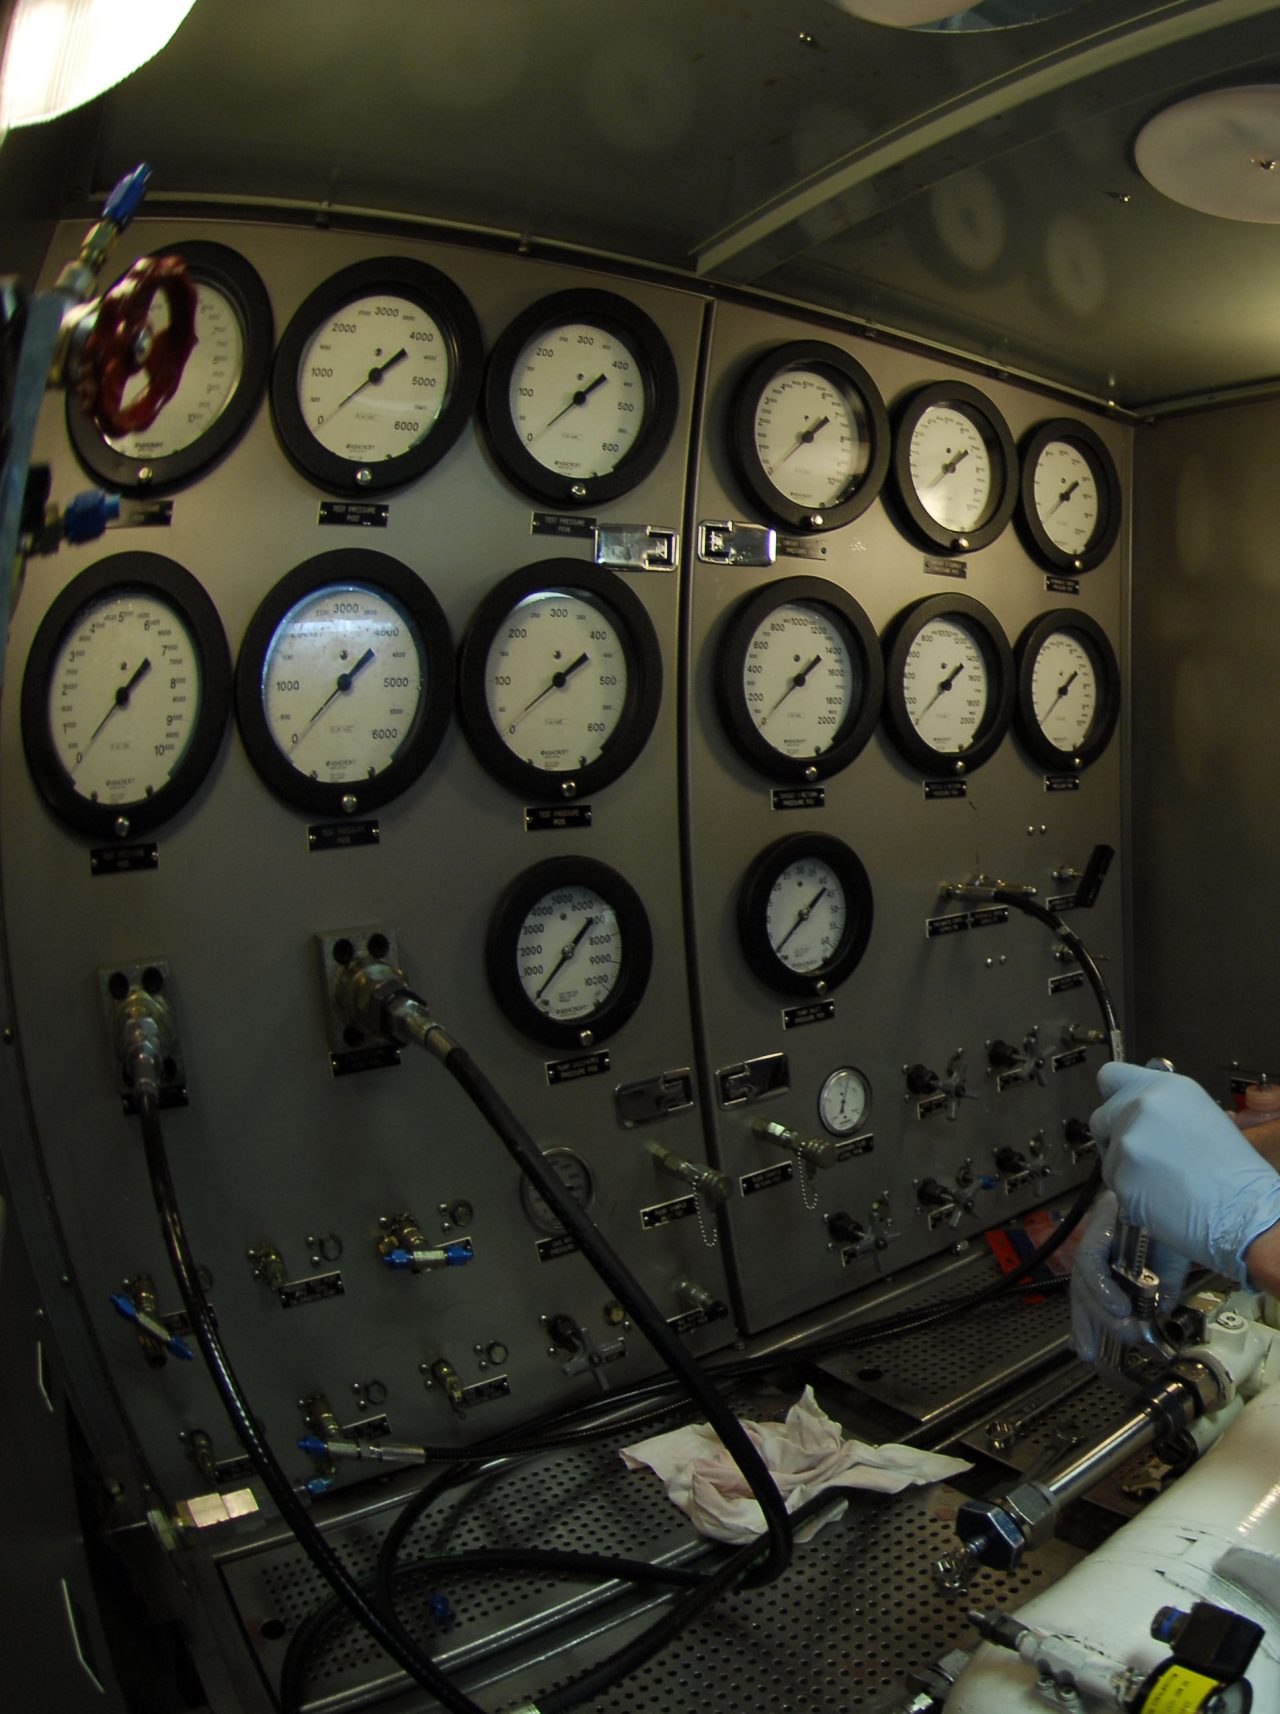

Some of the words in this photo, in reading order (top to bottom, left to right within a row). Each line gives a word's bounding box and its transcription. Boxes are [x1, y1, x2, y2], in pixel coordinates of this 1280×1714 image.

[375, 307, 399, 318] 3000
[332, 322, 357, 334] 2000
[409, 331, 434, 342] 4000
[577, 335, 594, 345] 300
[536, 347, 554, 358] 200
[612, 360, 629, 370] 400
[311, 368, 334, 378] 1000
[412, 376, 436, 387] 5000
[519, 388, 534, 397] 100
[618, 401, 633, 411] 500
[318, 415, 324, 424] 0
[394, 421, 419, 432] 6000
[527, 433, 533, 441] 0
[602, 442, 619, 452] 600
[333, 603, 359, 614] 3000
[550, 608, 568, 618] 300
[508, 628, 527, 639] 200
[589, 631, 607, 640] 400
[277, 680, 299, 691] 1000
[384, 677, 408, 688] 5000
[495, 676, 511, 685] 100
[600, 676, 616, 686] 500
[509, 725, 516, 734] 0
[588, 723, 606, 733] 600
[292, 734, 298, 744] 0
[372, 729, 397, 740] 6000
[552, 893, 573, 905] 5000
[571, 900, 593, 911] 6000
[531, 906, 553, 916] 4000
[584, 915, 605, 925] 700
[523, 924, 544, 935] 3000
[589, 935, 611, 945] 8000
[521, 945, 542, 955] 2000
[589, 954, 612, 965] 9000
[524, 965, 544, 976] 1000
